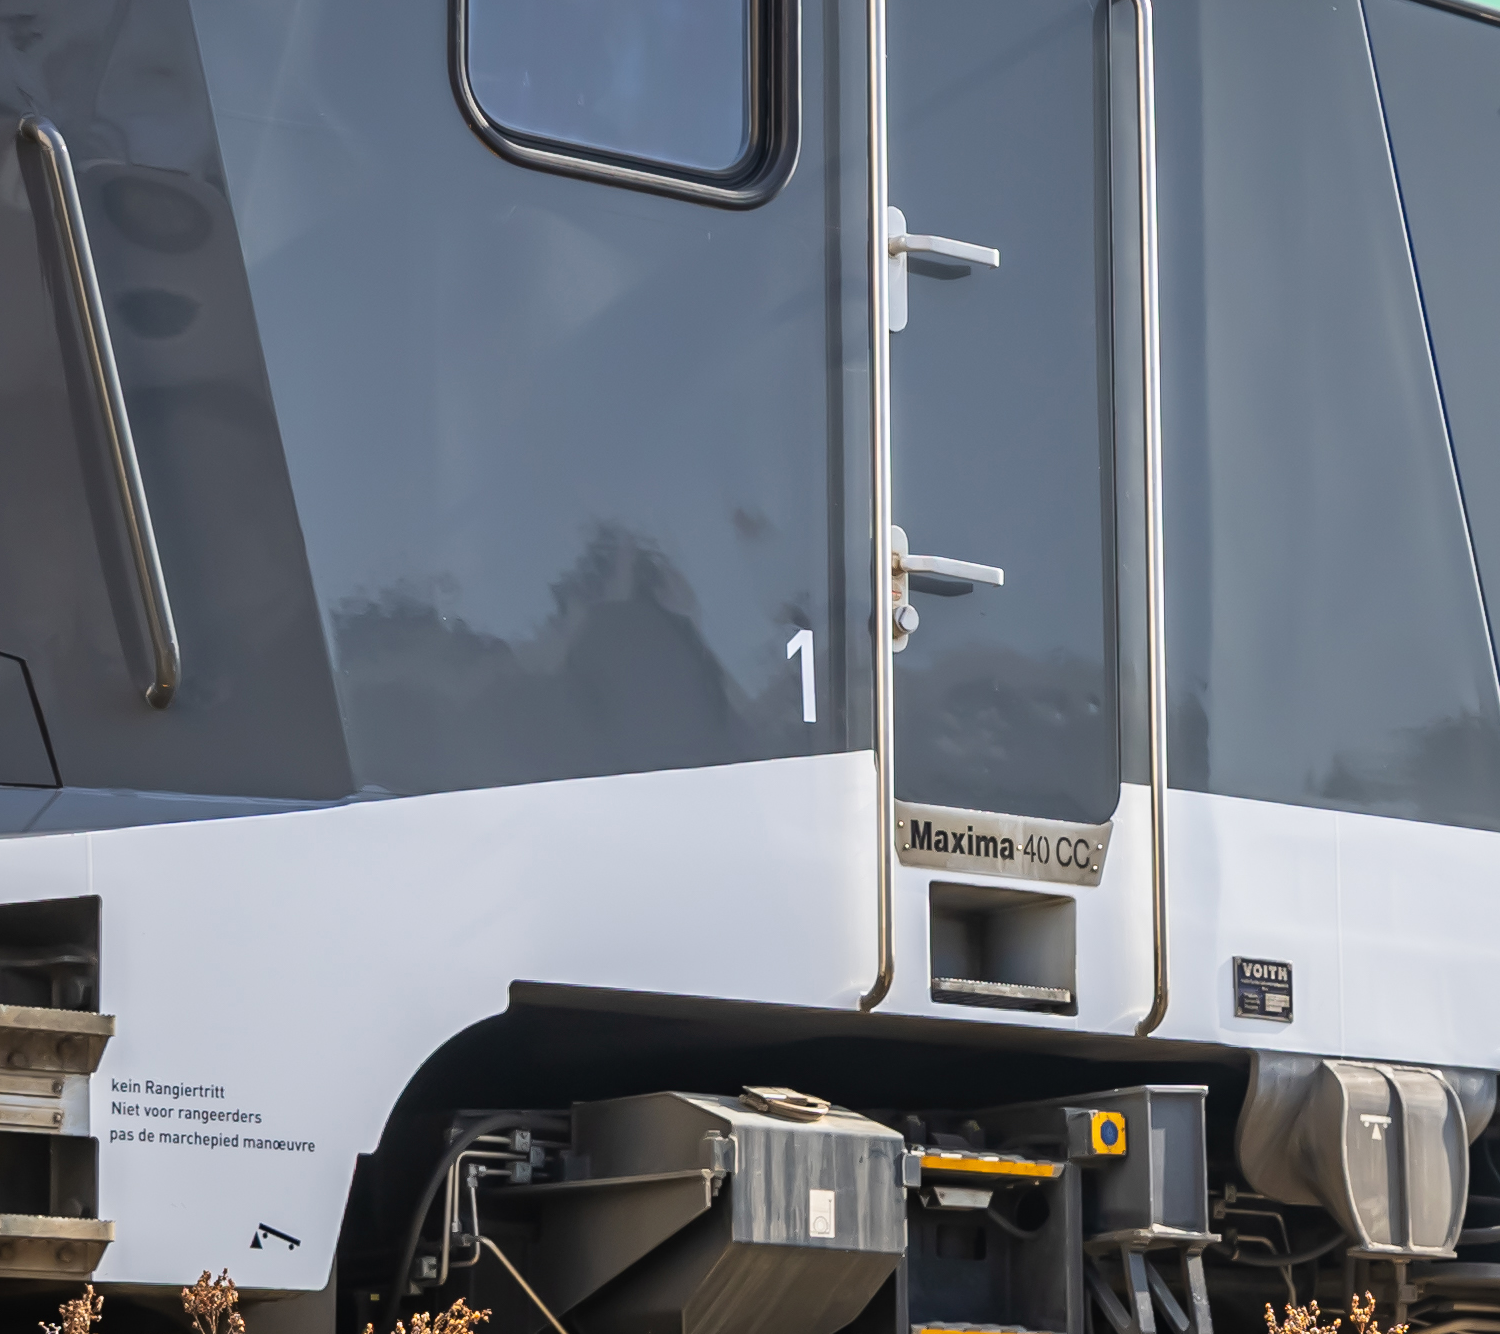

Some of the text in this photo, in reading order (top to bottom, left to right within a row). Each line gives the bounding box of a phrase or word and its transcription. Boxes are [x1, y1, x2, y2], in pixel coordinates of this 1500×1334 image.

[786, 630, 817, 722] 1
[910, 819, 1091, 869] Maxima 40 CC
[1242, 962, 1289, 981] VOITH
[111, 1078, 226, 1099] kein Rangiertritt
[111, 1101, 263, 1124] Niet voor rangeerders
[110, 1128, 316, 1153] pas de marchepied manœuvre
